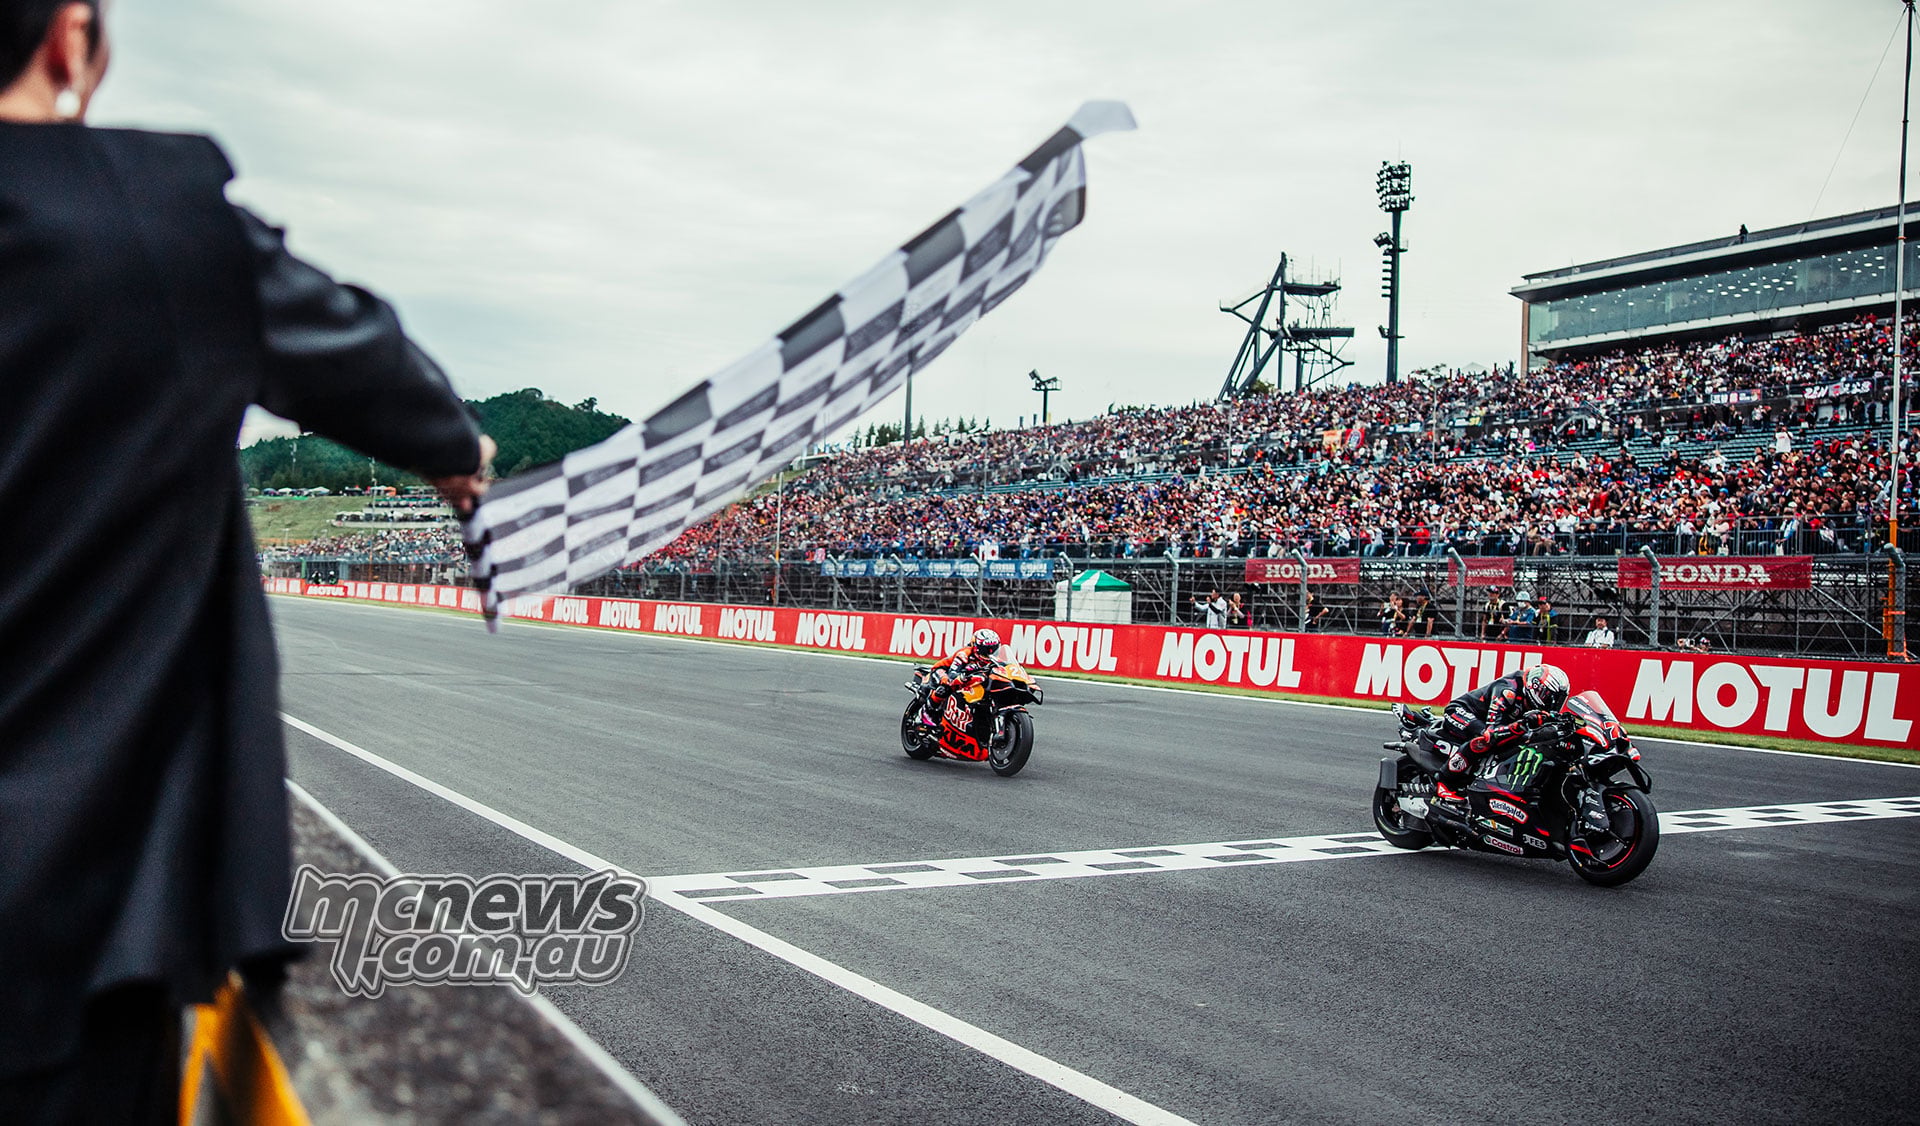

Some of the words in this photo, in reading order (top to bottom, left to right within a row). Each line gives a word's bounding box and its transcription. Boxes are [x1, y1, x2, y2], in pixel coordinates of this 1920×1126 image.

[1659, 564, 1772, 584] HONDA
[307, 585, 345, 596] MOTUL
[552, 598, 589, 624] MOTUL
[599, 600, 641, 629] MOTUL
[653, 604, 703, 635] MOTUL
[718, 608, 777, 642] MOTUL
[795, 612, 866, 651] MOTUL
[1010, 624, 1118, 672] MOTUL
[1156, 631, 1302, 688] MOTUL
[1625, 658, 1913, 743] MOTUL
[1491, 838, 1521, 854] Castrol
